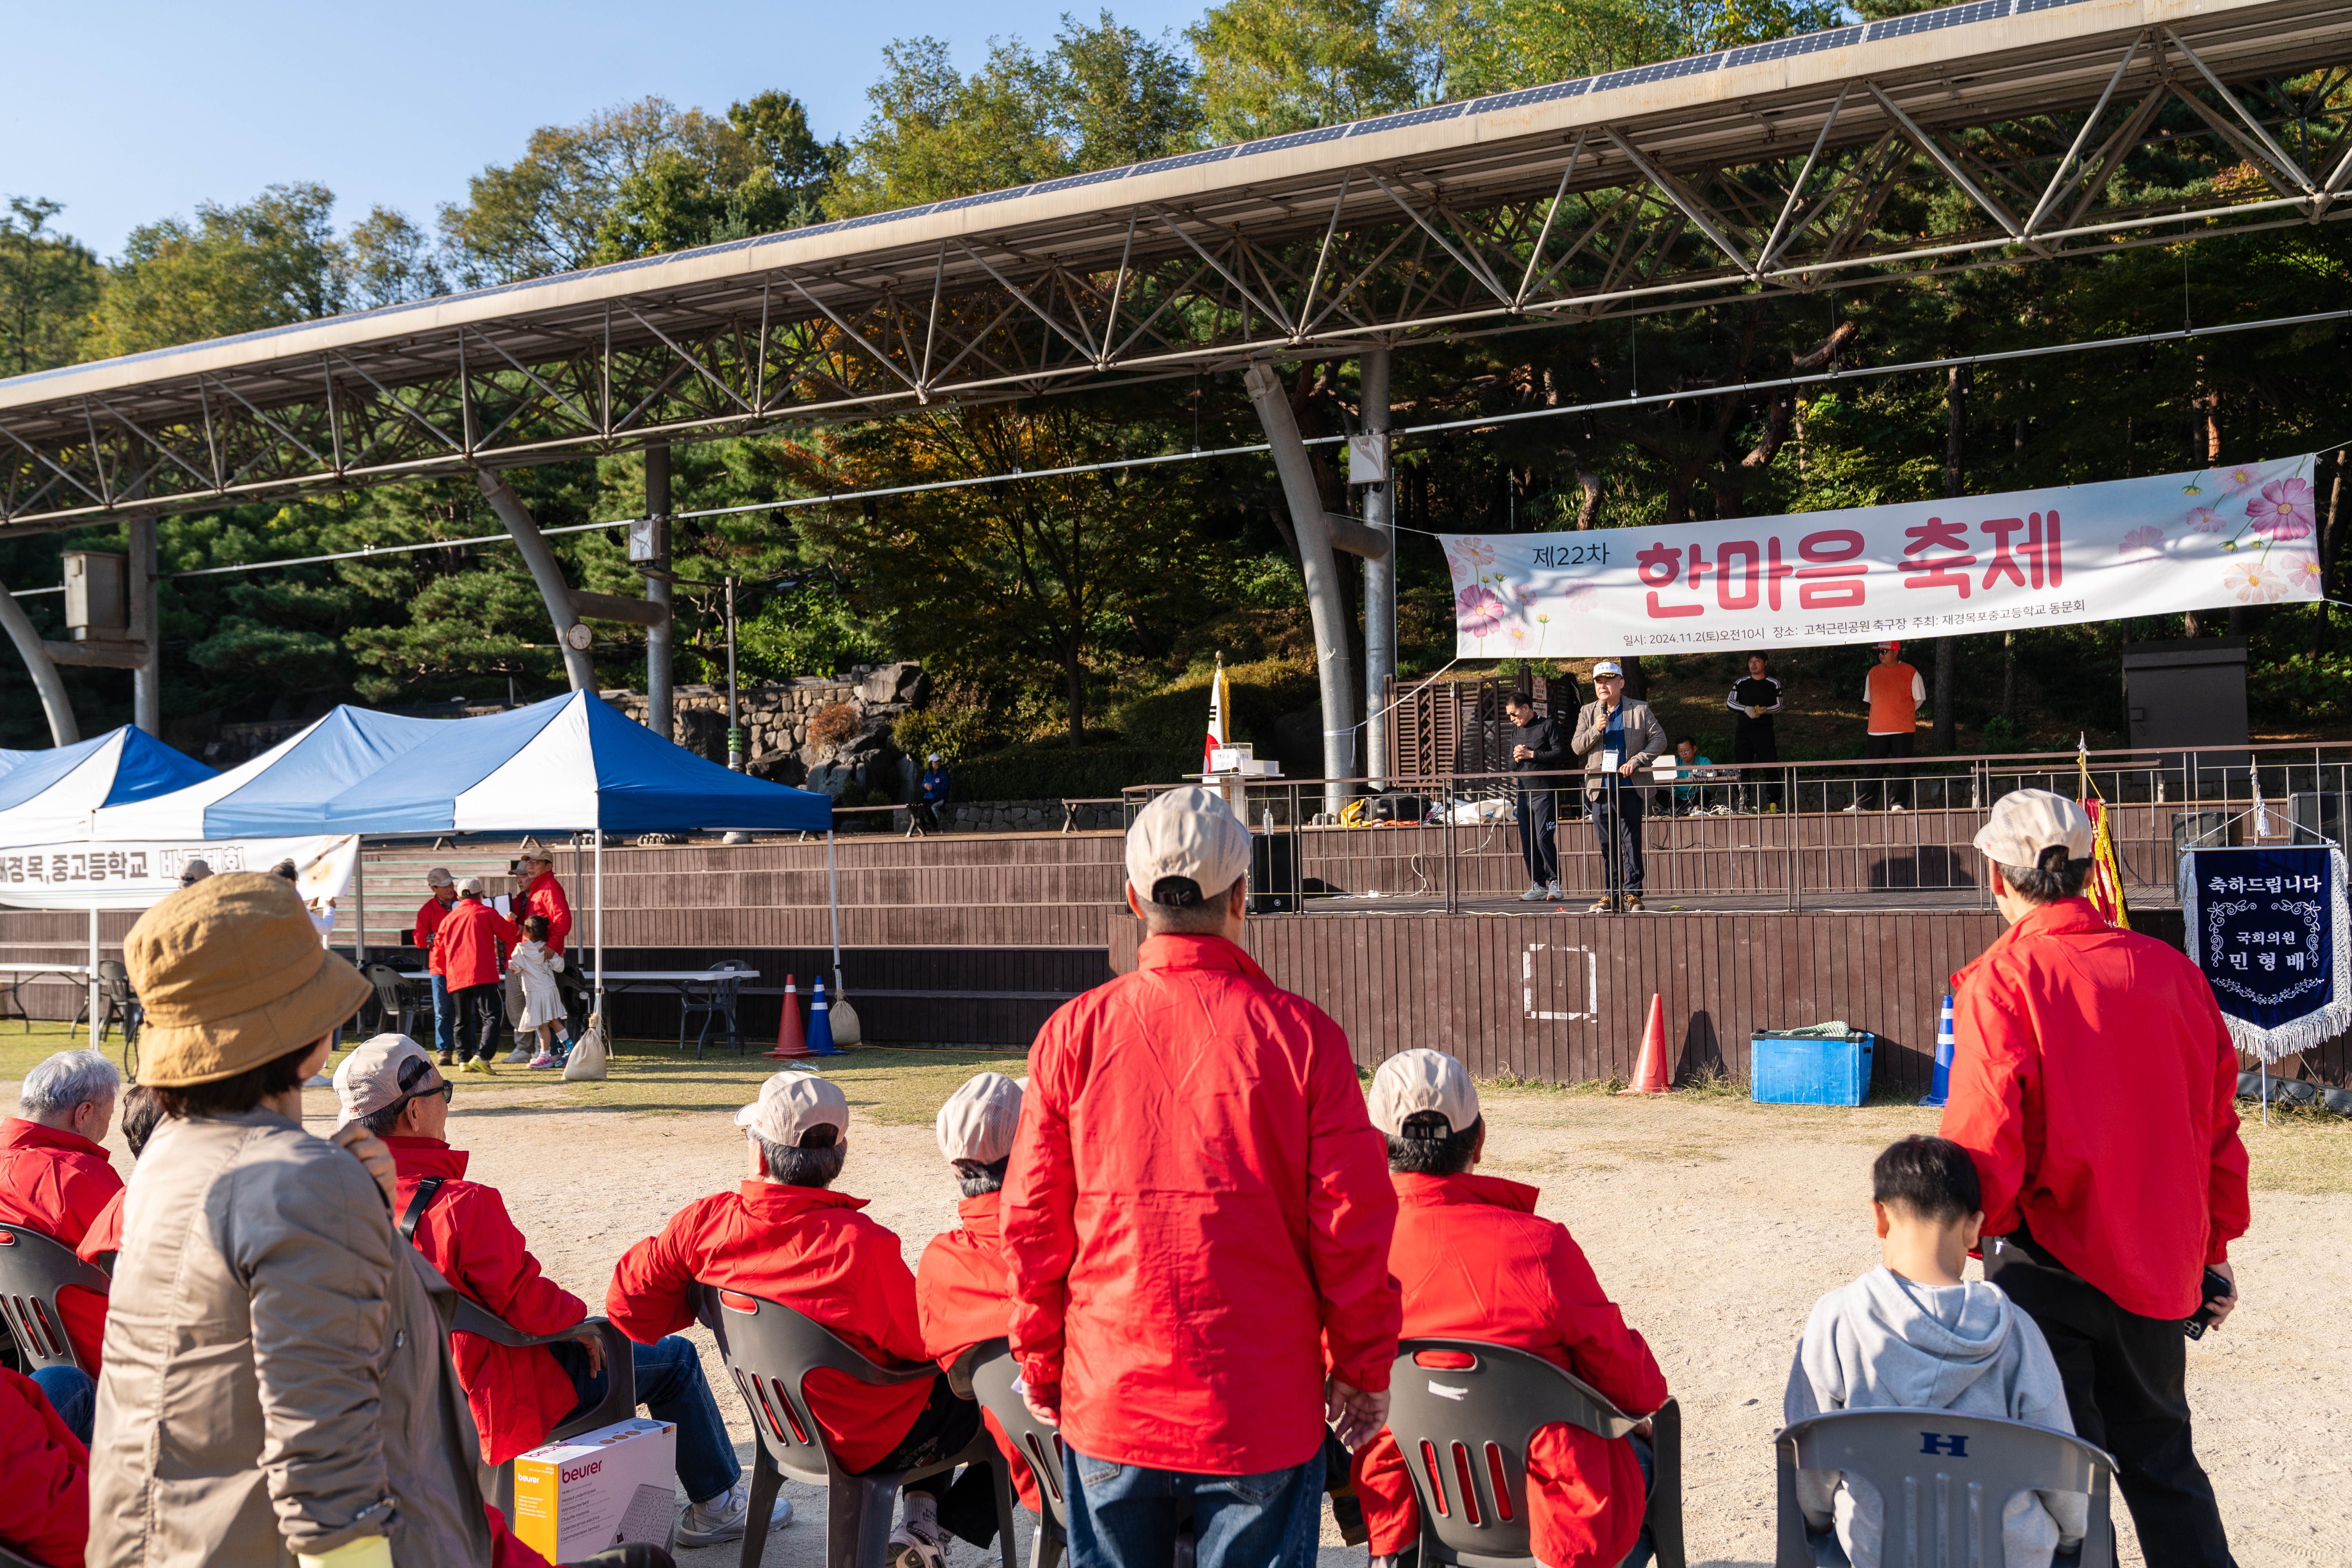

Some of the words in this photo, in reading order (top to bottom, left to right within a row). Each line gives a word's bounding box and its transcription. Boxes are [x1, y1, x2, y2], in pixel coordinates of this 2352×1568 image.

[1533, 542, 1610, 568] 제22차
[1636, 529, 1869, 619] 한마음
[1897, 509, 2062, 599] 축제
[1623, 634, 1647, 646] 일시:
[1649, 627, 1765, 644] 2024.11.2(토)오전10시
[1773, 626, 1798, 639] 장소:
[1804, 620, 1870, 635] 고척근린공원
[1872, 617, 1907, 631] 축구장
[1912, 615, 1938, 629] 주최:
[1942, 604, 2047, 626] 재경목포중고등학교
[2049, 599, 2085, 615] 동문회
[2208, 875, 2322, 894] 축하드립니다
[2236, 931, 2296, 946] 국회의원
[524, 1442, 572, 1457] beurer
[1920, 1431, 1969, 1457] H
[517, 1472, 540, 1484] beurer
[562, 1459, 602, 1484] beurer
